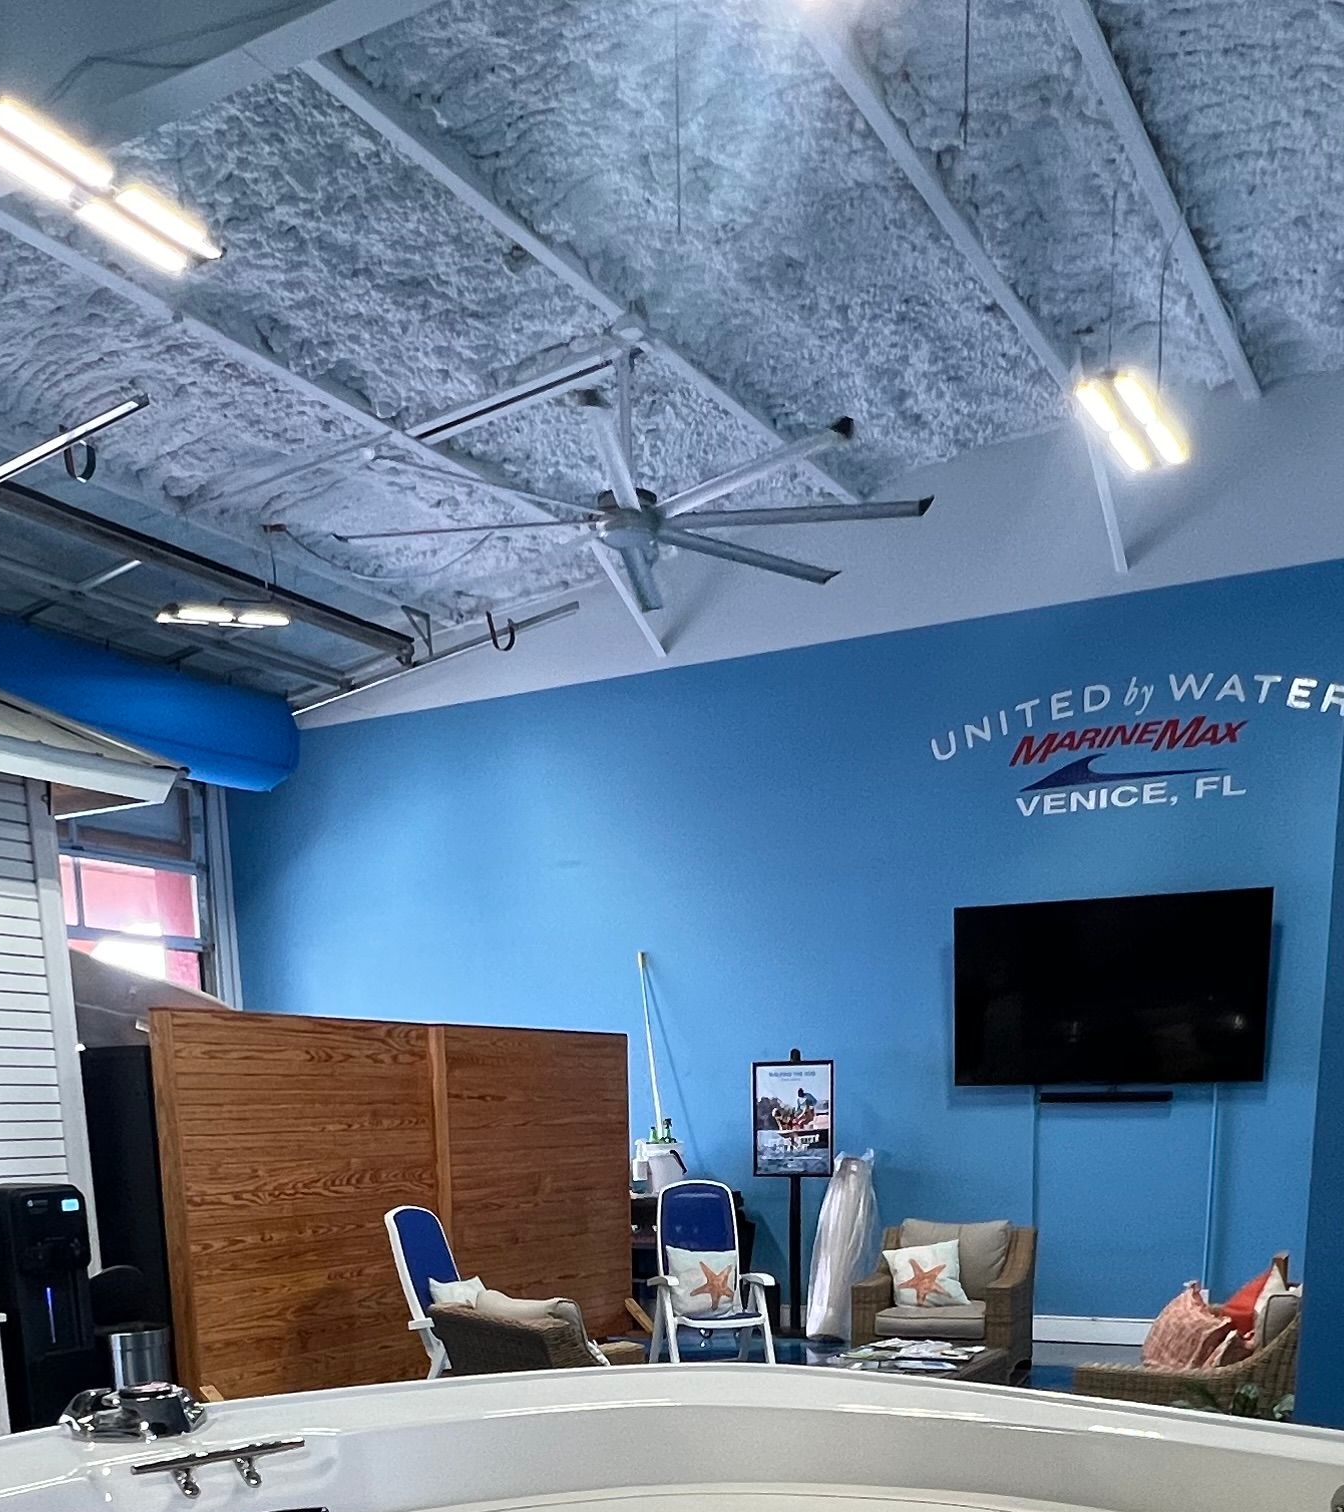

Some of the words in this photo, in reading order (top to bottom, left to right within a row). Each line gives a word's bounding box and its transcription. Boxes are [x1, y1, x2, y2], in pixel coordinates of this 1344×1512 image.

[930, 683, 1111, 761] UNITED
[1123, 676, 1155, 716] by
[1015, 781, 1179, 817] VENICE,
[1195, 775, 1248, 799] FL
